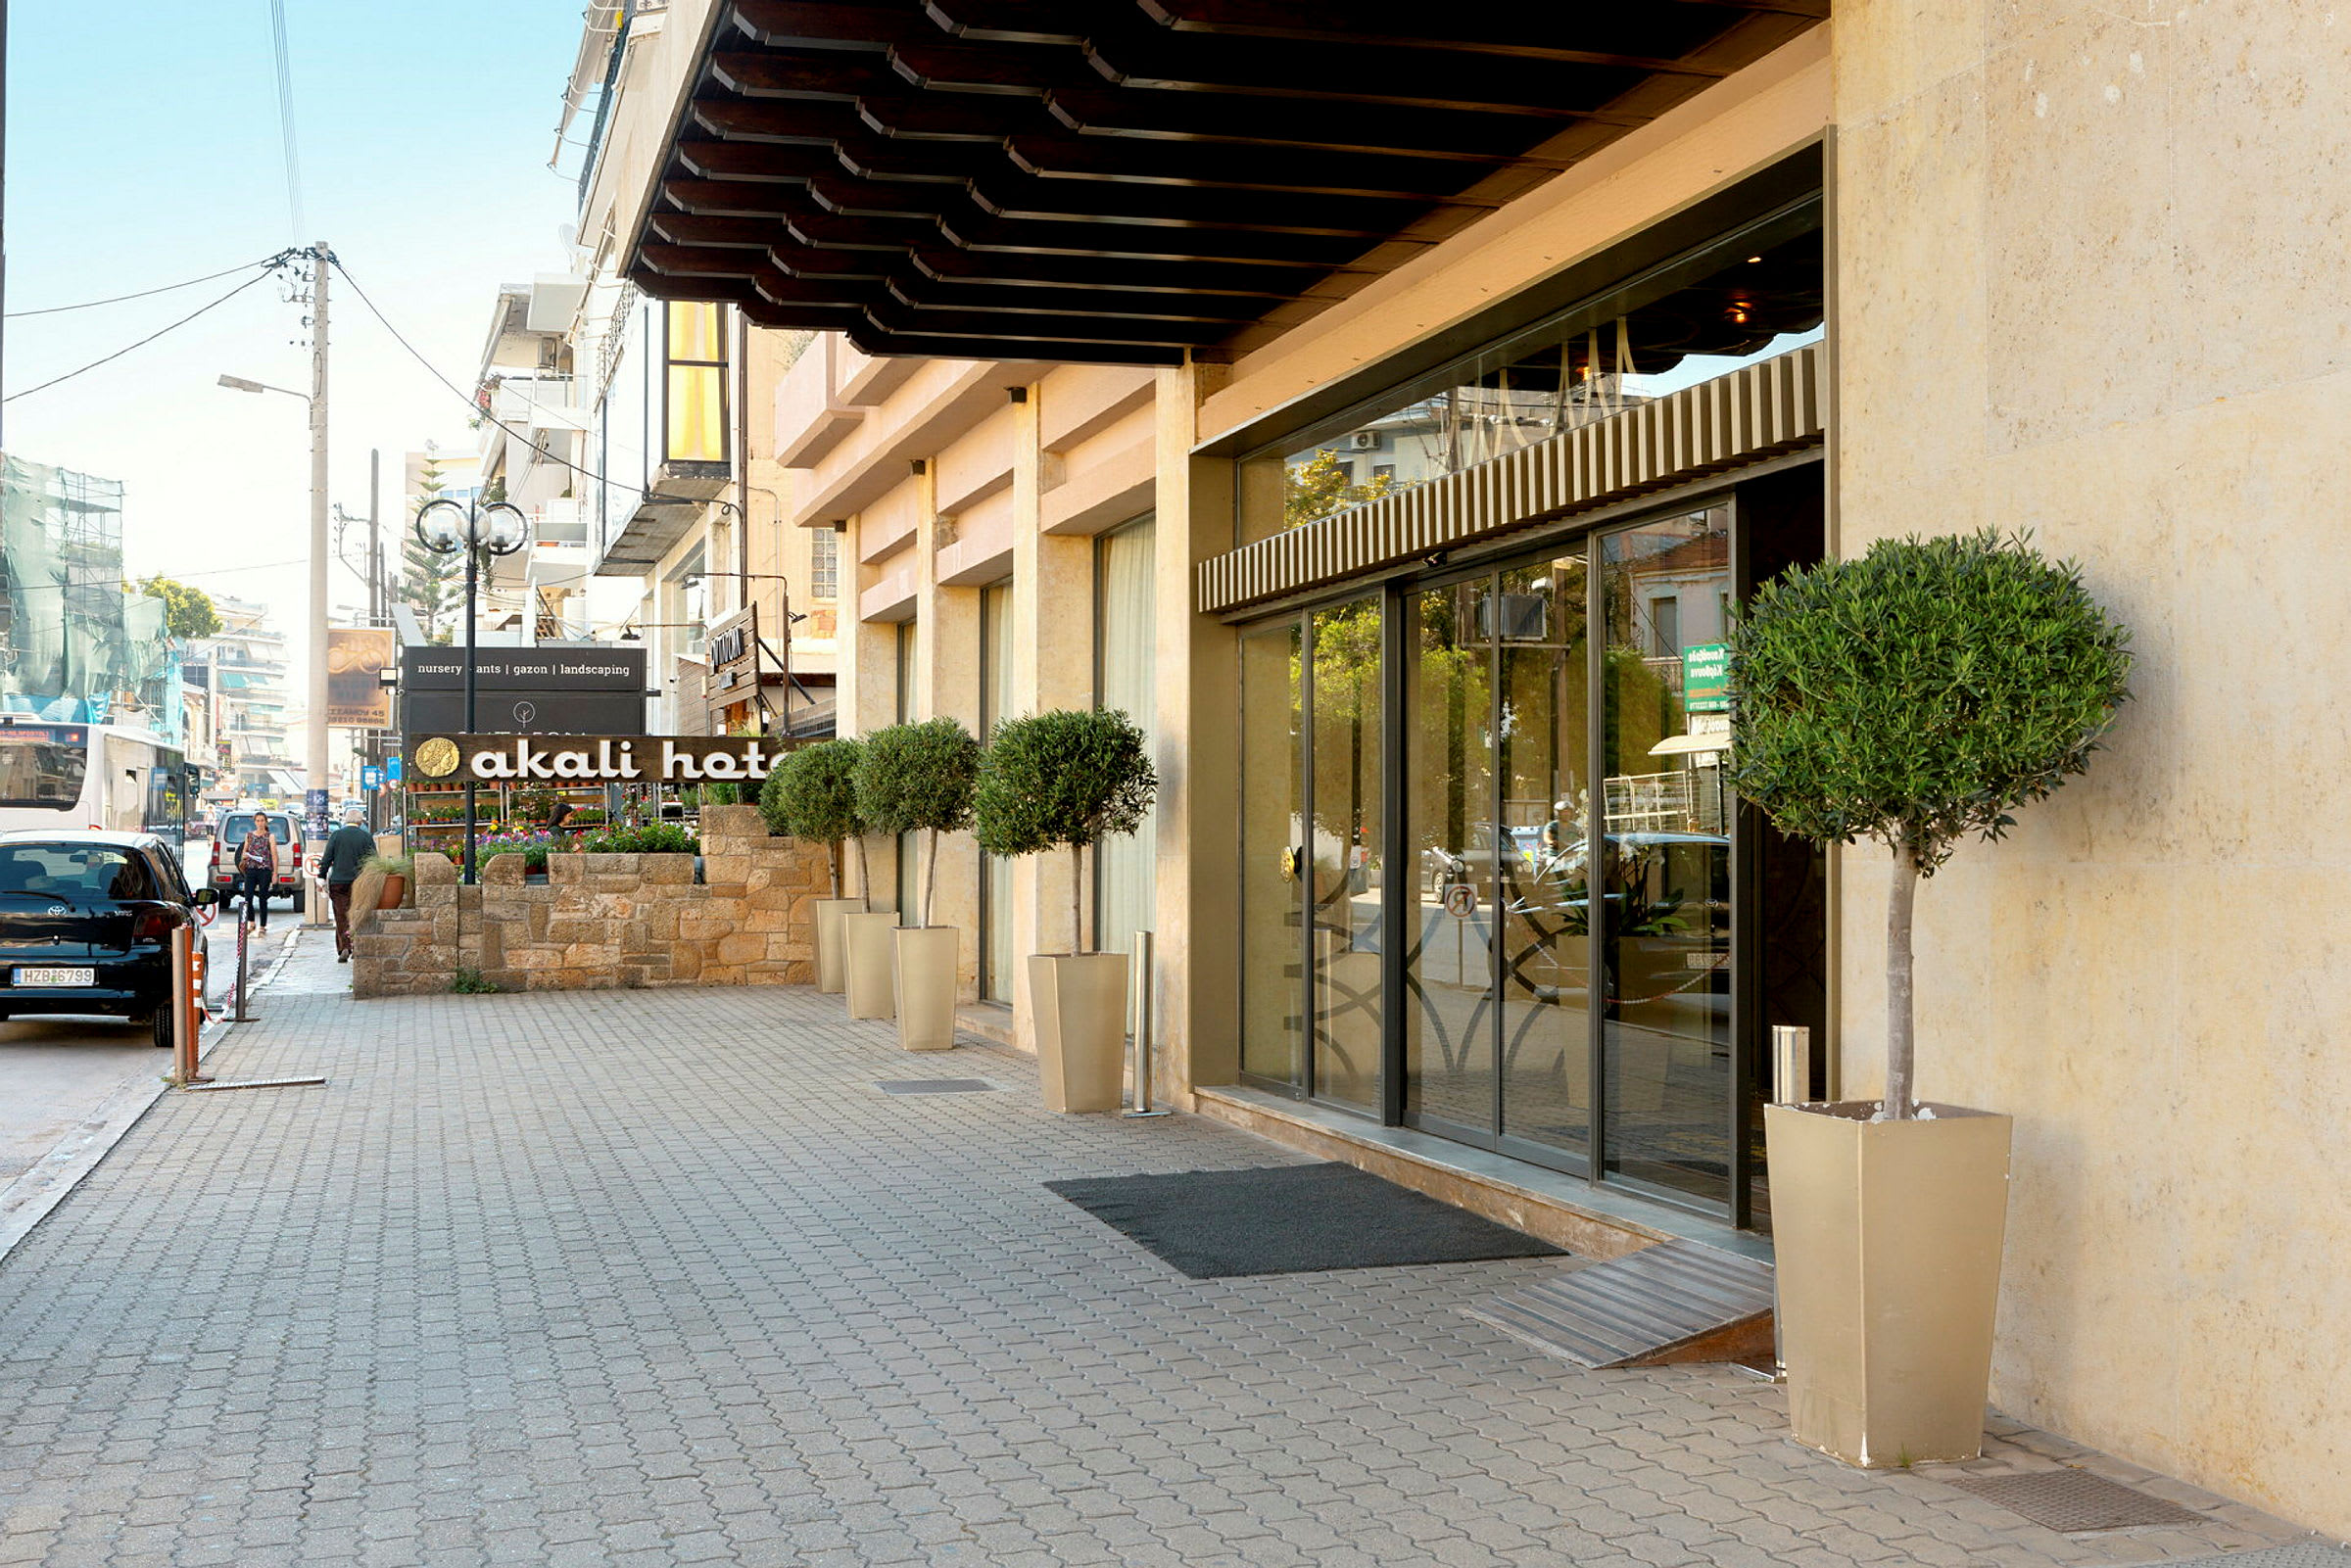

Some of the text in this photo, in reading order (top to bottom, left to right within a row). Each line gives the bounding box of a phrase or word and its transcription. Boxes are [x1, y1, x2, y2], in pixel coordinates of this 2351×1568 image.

[417, 665, 462, 676] nursery
[468, 664, 501, 674] ants
[513, 665, 548, 676] gazon
[560, 664, 630, 676] landscaping
[470, 738, 791, 780] akali hot
